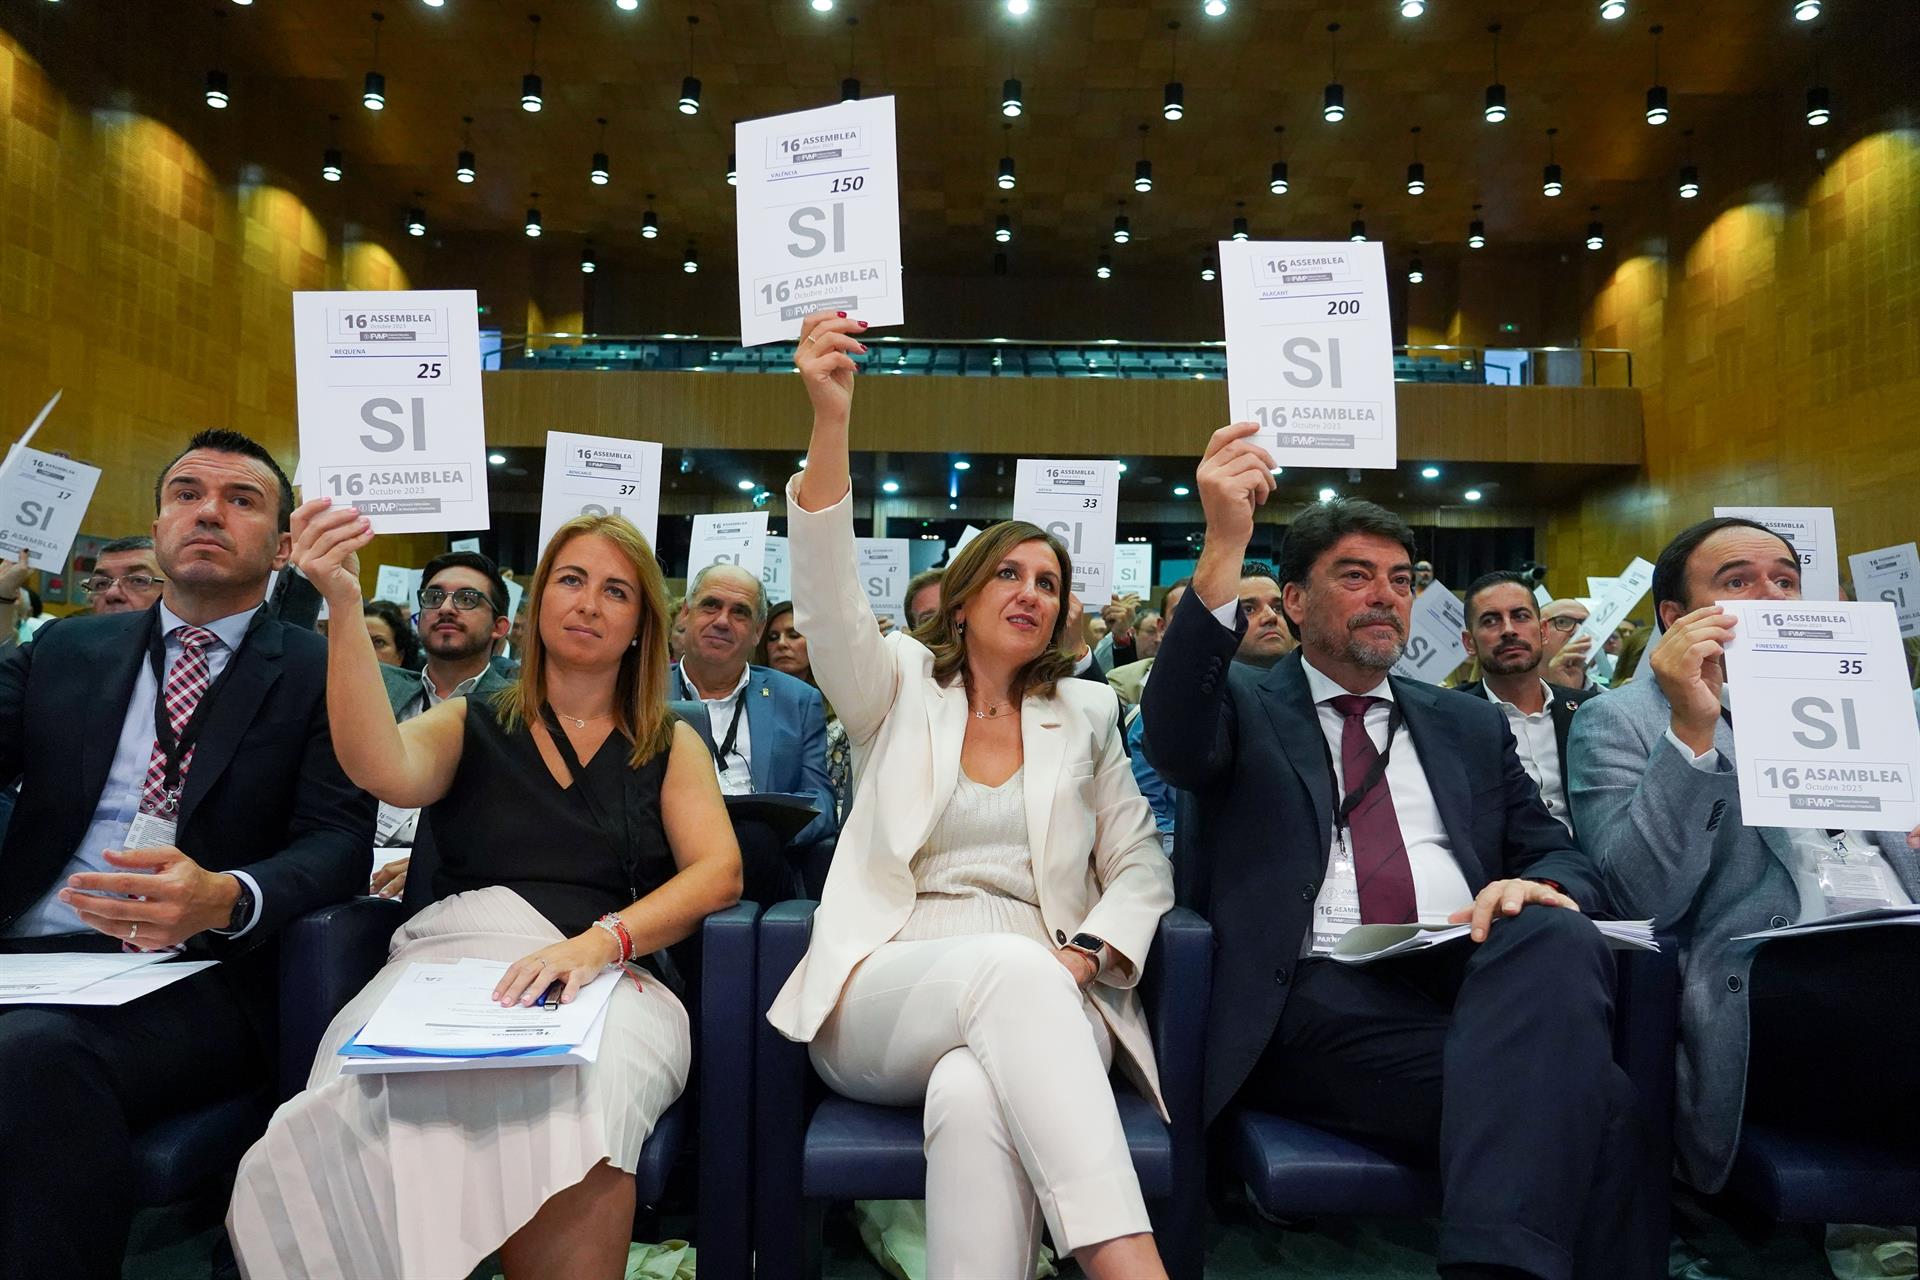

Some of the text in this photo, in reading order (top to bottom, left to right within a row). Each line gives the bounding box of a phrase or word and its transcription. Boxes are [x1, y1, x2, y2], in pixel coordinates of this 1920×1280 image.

[781, 139, 800, 153] 16
[803, 132, 857, 145] ASSEMBLEA
[830, 176, 864, 194] 150
[787, 202, 846, 259] SI
[1267, 257, 1345, 273] 16 ASSEMBLEA
[761, 268, 879, 305] 16 ASAMBLEA
[795, 304, 817, 316] FVMP
[1327, 300, 1360, 316] 200
[344, 314, 432, 329] 16 ASSEMBLEA
[1282, 336, 1342, 389] SI
[417, 363, 442, 379] 25
[359, 397, 427, 453] SI
[1255, 406, 1375, 428] 16 ASAMBLEA
[577, 449, 592, 459] 16
[593, 450, 632, 459] ASSEMBLEA
[1046, 469, 1059, 478] 16
[327, 470, 464, 496] 16 ASAMBLEA
[619, 485, 636, 495] 37
[57, 491, 72, 500] 17
[369, 487, 425, 496] Octubre 2023
[370, 502, 396, 512] FVMP
[1082, 498, 1098, 509] 33
[16, 500, 55, 532] SI
[1764, 521, 1805, 529] ASSEMBLEA
[0, 529, 9, 541] 6
[1046, 521, 1083, 555] SI
[1072, 566, 1100, 576] BLEA
[1120, 568, 1137, 581] SI
[868, 576, 891, 597] SI
[1880, 587, 1906, 608] SI
[1762, 613, 1846, 626] 16 ASSEMBLEA
[1403, 636, 1437, 669] SI
[1838, 659, 1863, 675] 35
[1791, 696, 1861, 750] SI
[1763, 767, 1902, 789] 16 ASAMBLEA
[1805, 782, 1863, 792] Octubre 2023
[1807, 797, 1833, 807] FVMP
[1318, 906, 1333, 915] 16
